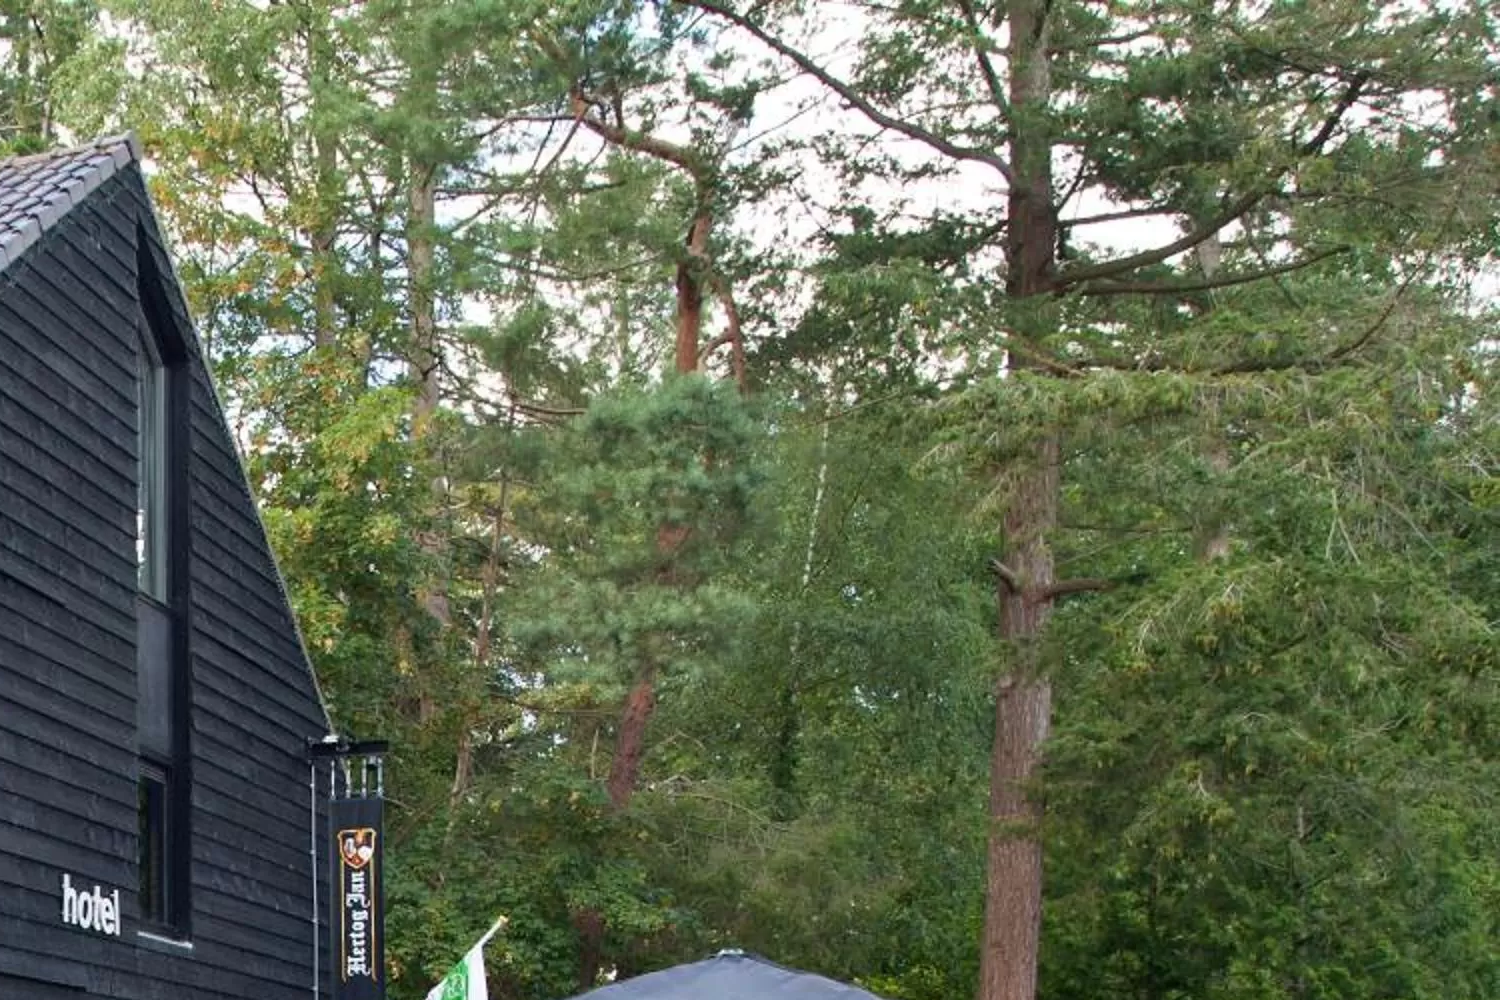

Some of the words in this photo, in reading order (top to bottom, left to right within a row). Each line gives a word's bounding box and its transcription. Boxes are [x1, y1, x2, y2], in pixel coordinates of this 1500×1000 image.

[62, 873, 120, 936] hotel
[346, 871, 371, 907] Jan
[346, 908, 372, 977] Hertog
